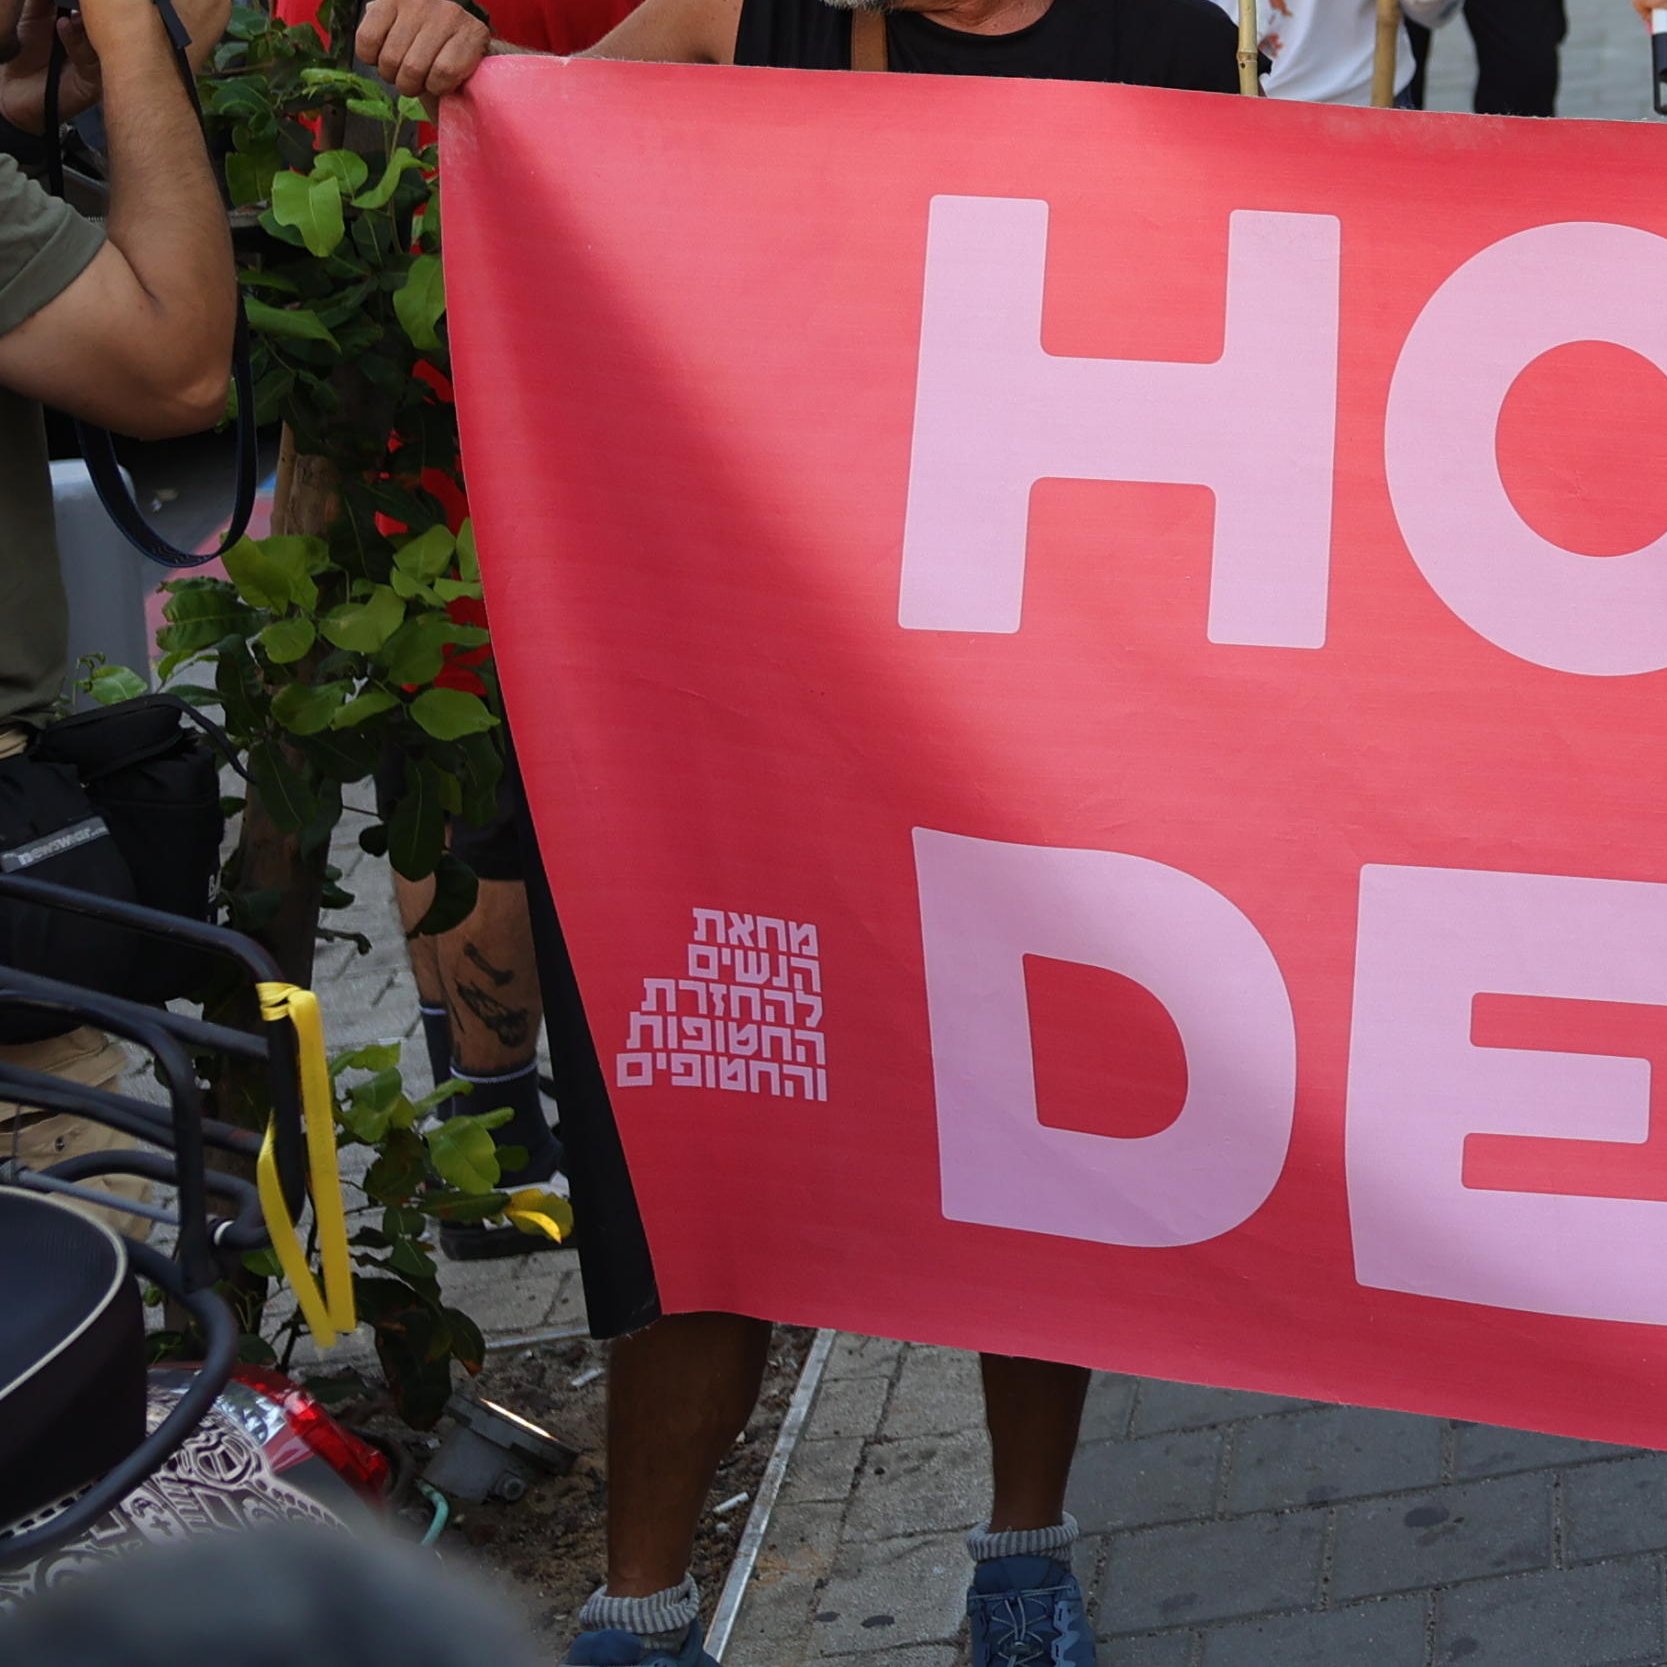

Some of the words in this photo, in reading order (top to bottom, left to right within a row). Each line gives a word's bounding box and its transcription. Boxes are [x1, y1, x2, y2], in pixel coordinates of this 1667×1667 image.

[693, 907, 820, 957] מחאת
[688, 943, 822, 994] הנשים
[640, 977, 823, 1029] להחזרת
[625, 1011, 826, 1066] החטופות
[616, 1051, 828, 1102] והחטופים
